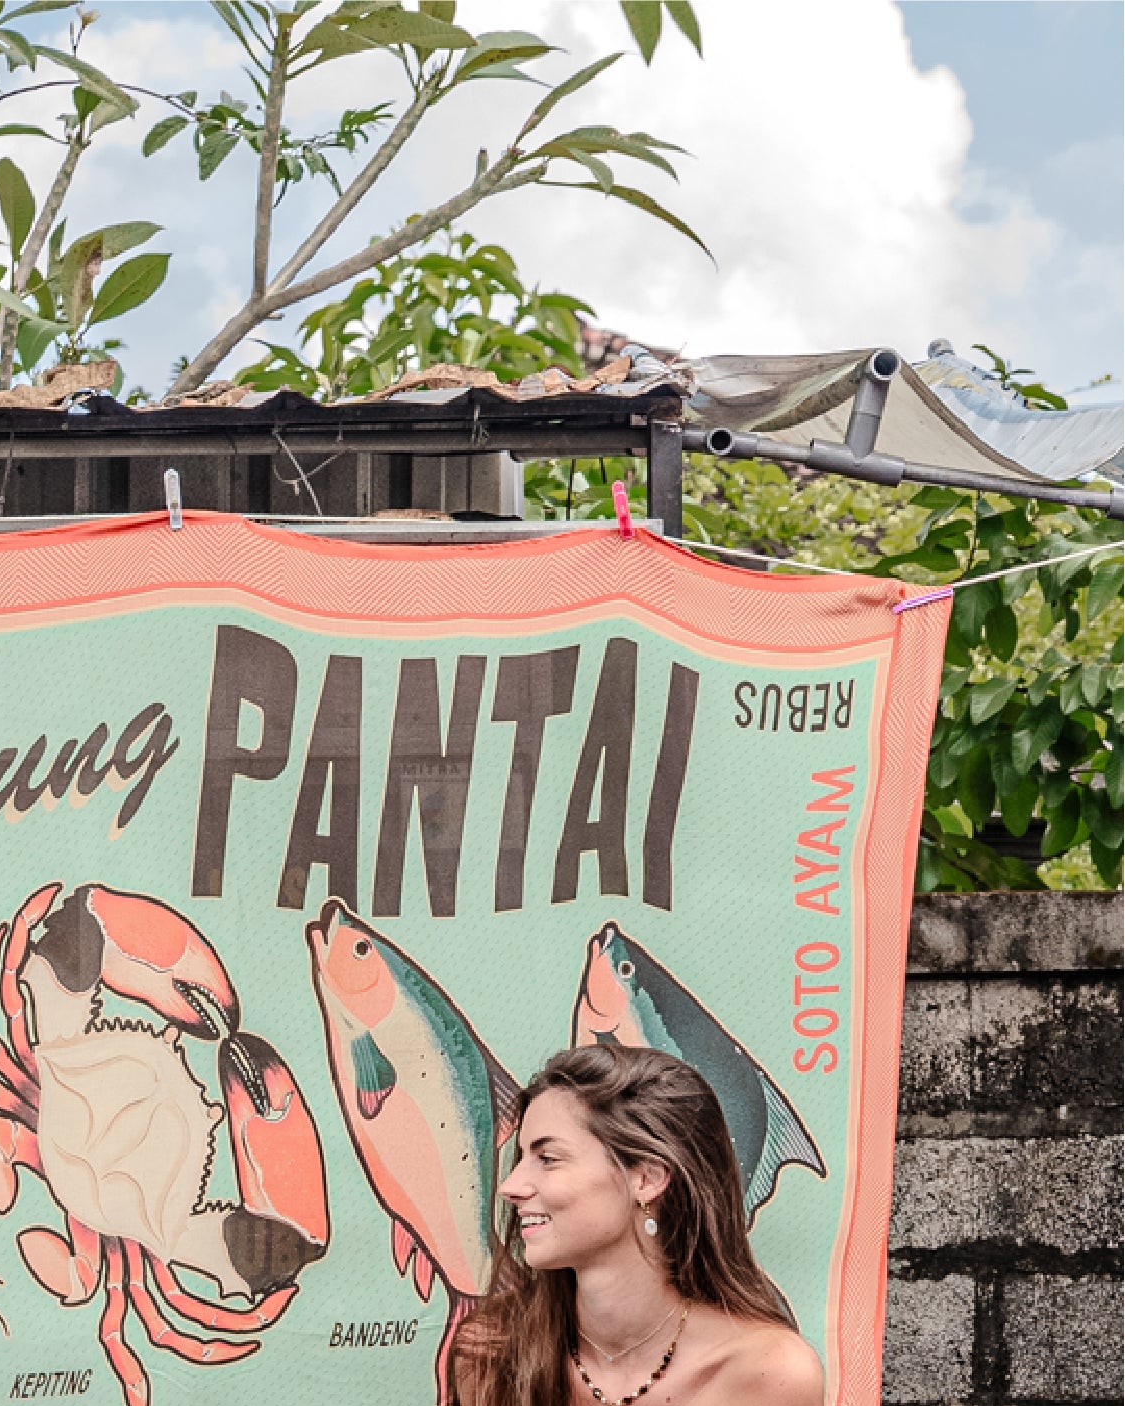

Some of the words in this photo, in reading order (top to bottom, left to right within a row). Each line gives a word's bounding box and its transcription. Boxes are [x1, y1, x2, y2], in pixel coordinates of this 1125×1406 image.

[734, 679, 854, 733] REBUS
[190, 624, 700, 917] PANTAI
[793, 765, 856, 917] AYAM
[793, 942, 841, 1074] SOTO
[329, 1318, 419, 1348] BANDENG
[9, 1368, 92, 1399] KEPITING
